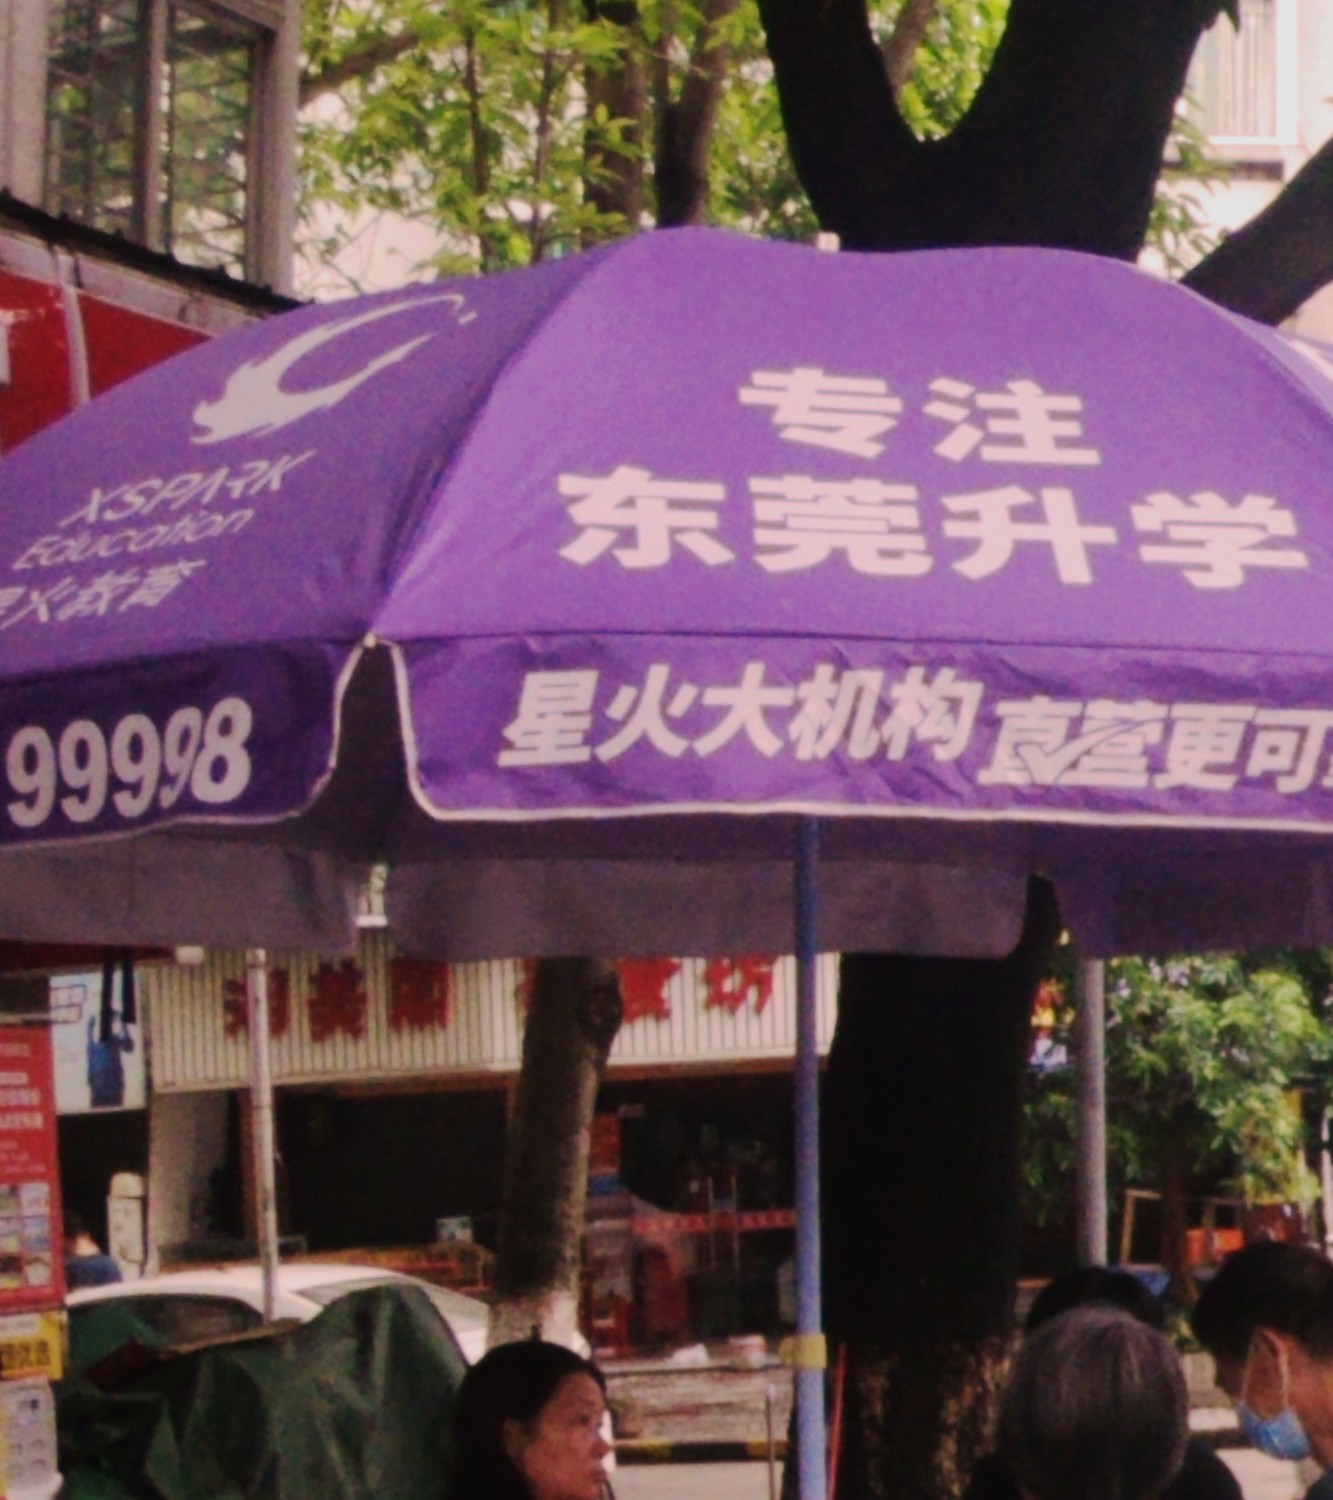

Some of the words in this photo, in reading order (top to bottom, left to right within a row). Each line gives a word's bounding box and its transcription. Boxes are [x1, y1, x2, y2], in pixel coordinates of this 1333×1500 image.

[737, 367, 1102, 467] 专注
[556, 465, 1309, 590] 东莞升学
[6, 696, 253, 828] 99998
[497, 661, 985, 769] 星火大机构
